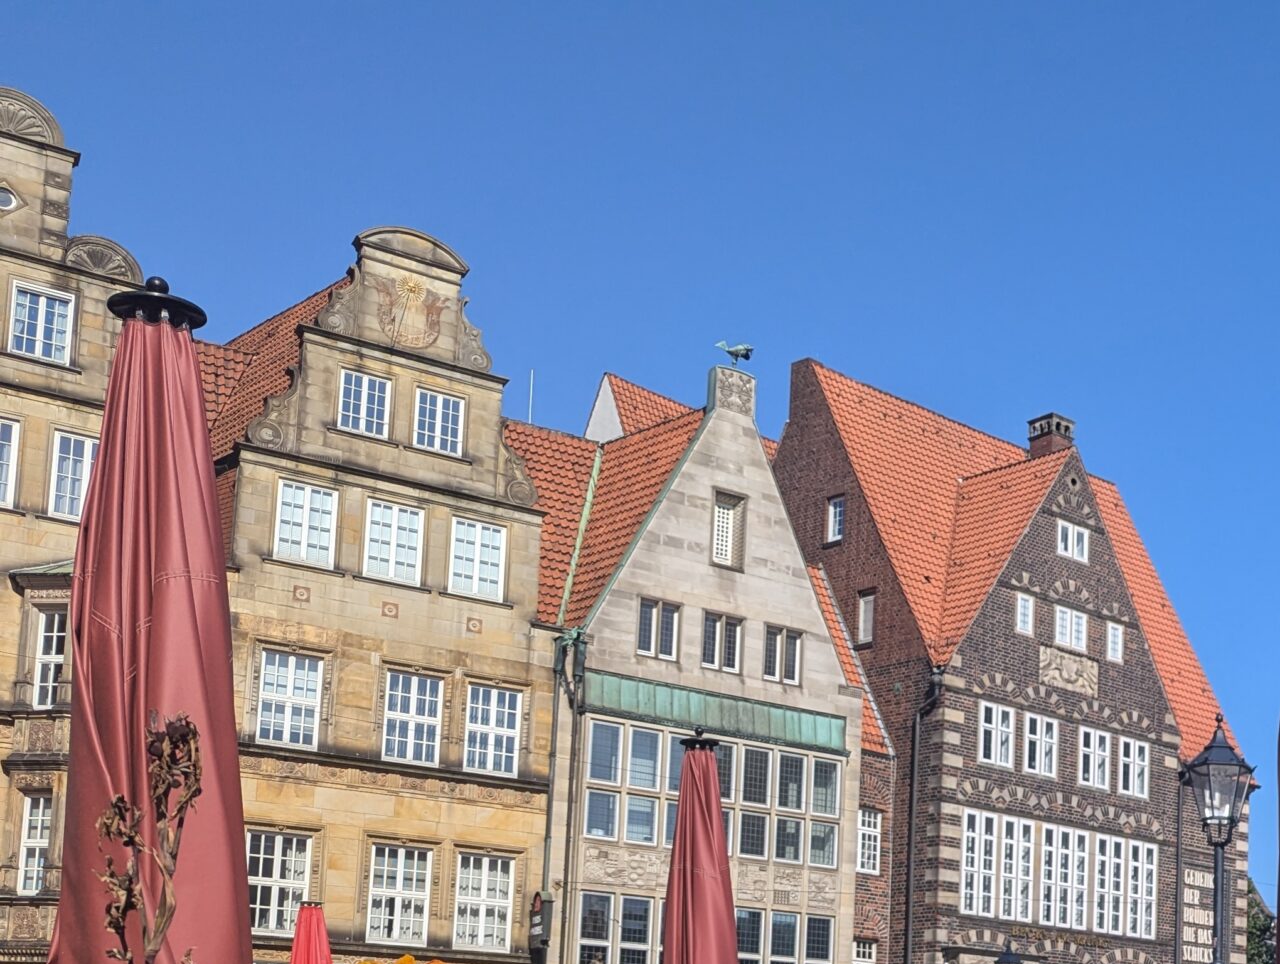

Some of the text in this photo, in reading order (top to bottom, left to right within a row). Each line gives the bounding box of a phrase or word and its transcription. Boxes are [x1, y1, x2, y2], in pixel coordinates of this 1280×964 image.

[1184, 868, 1215, 889] GEDENK
[1183, 887, 1201, 905] DER
[1183, 925, 1196, 942] DIE
[1182, 945, 1213, 963] SCHICKS
